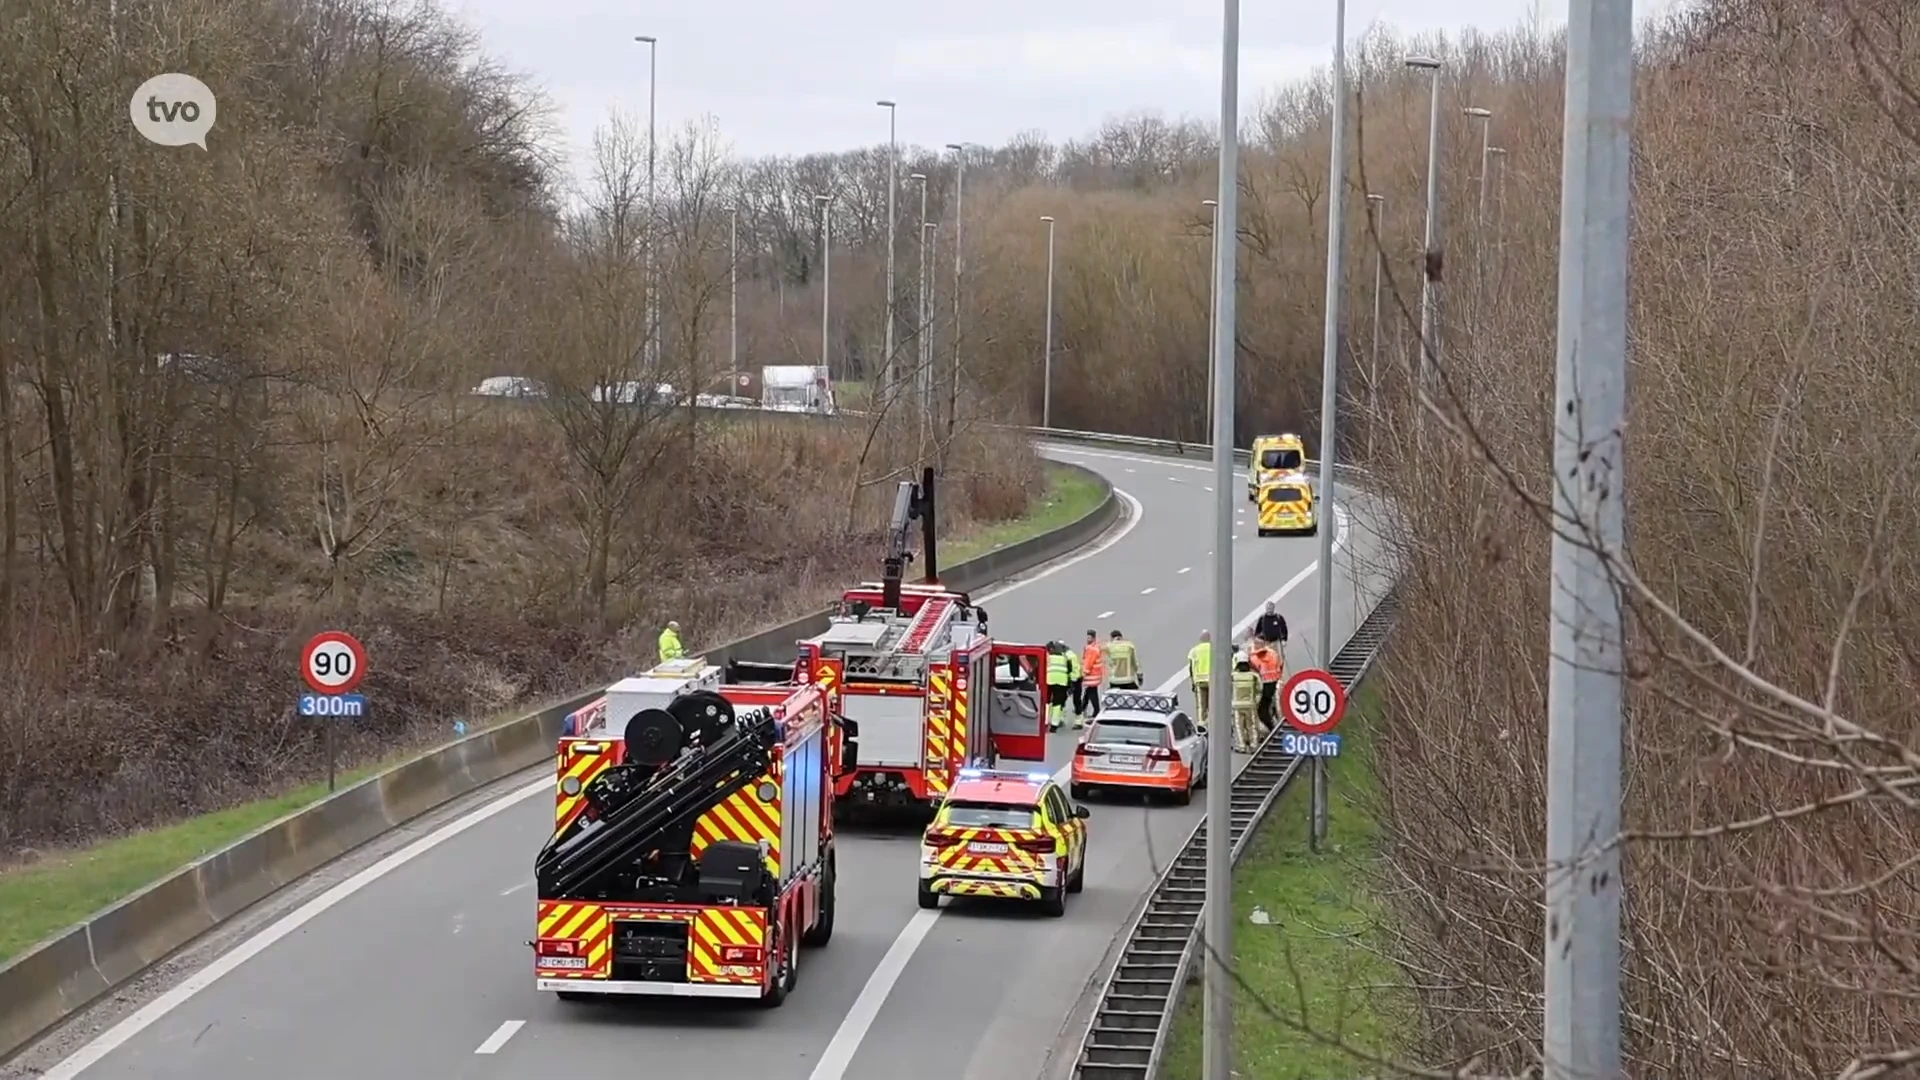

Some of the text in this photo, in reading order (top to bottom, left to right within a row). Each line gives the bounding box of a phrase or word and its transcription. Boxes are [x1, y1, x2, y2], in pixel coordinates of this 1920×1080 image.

[314, 652, 351, 676] 90
[303, 696, 361, 715] 300m
[1295, 690, 1331, 715] 90
[1285, 734, 1337, 756] 300m
